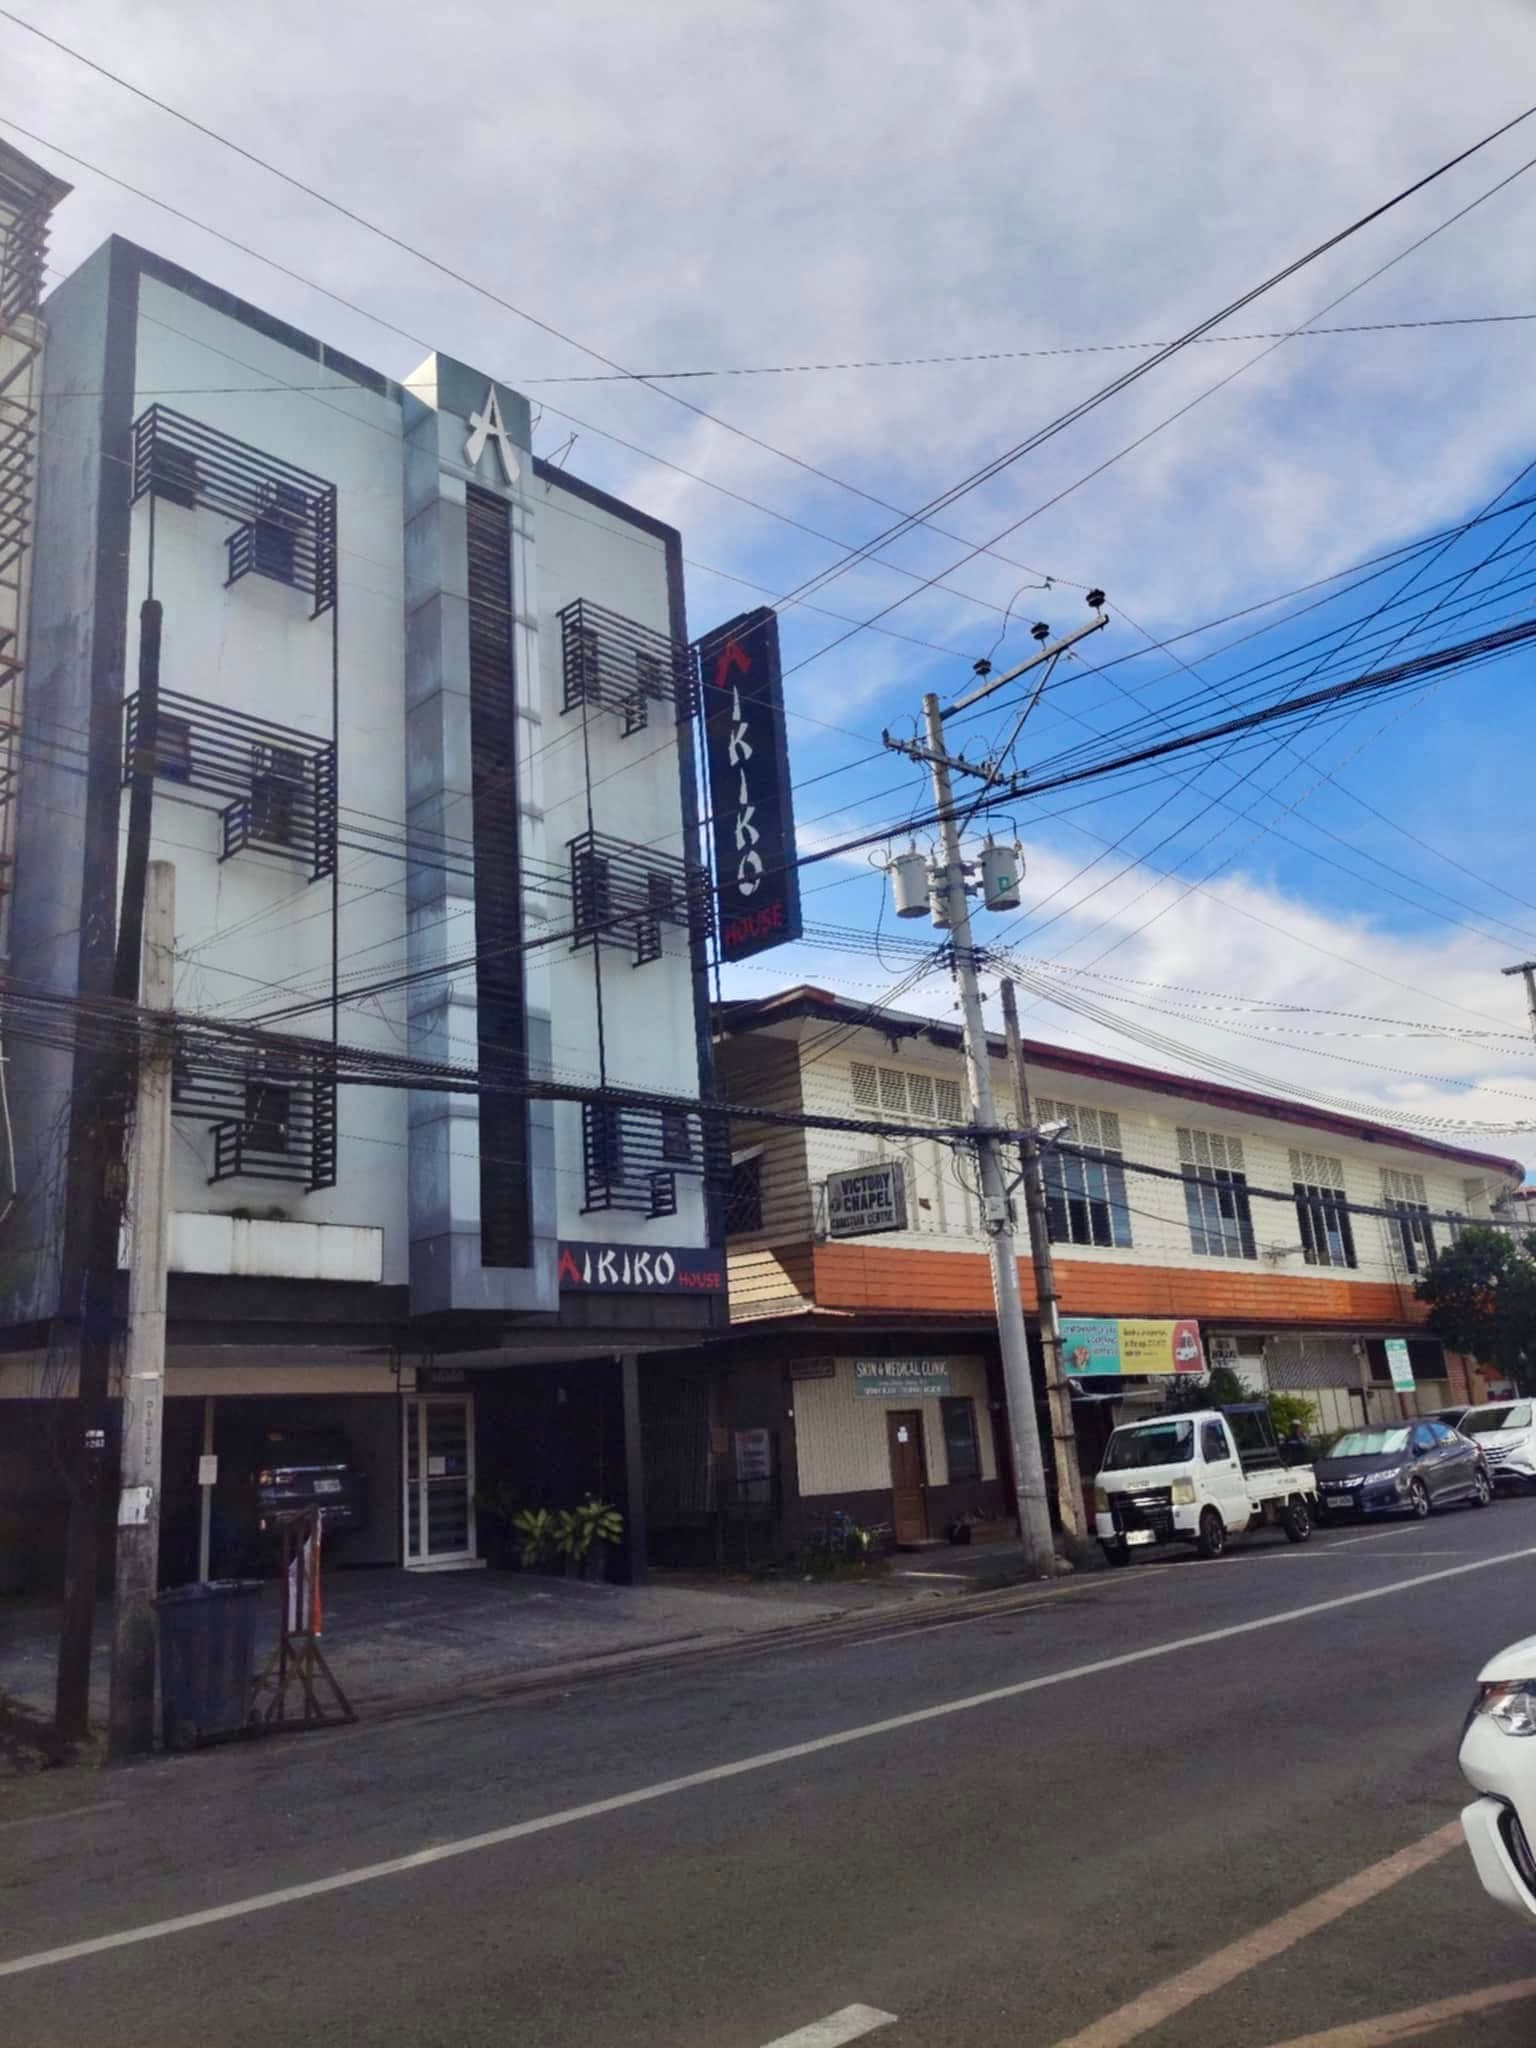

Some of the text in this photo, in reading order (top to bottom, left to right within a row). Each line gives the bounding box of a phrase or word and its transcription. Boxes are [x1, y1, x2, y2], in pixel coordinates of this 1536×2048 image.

[464, 383, 520, 484] A
[725, 903, 784, 945] HOUSE
[841, 1172, 890, 1195] VICTORY
[843, 1191, 892, 1212] CHAPEL
[557, 1248, 721, 1289] AIKIKO HOUSE
[855, 1361, 877, 1377] SKIN
[884, 1360, 921, 1377] MEDICAL
